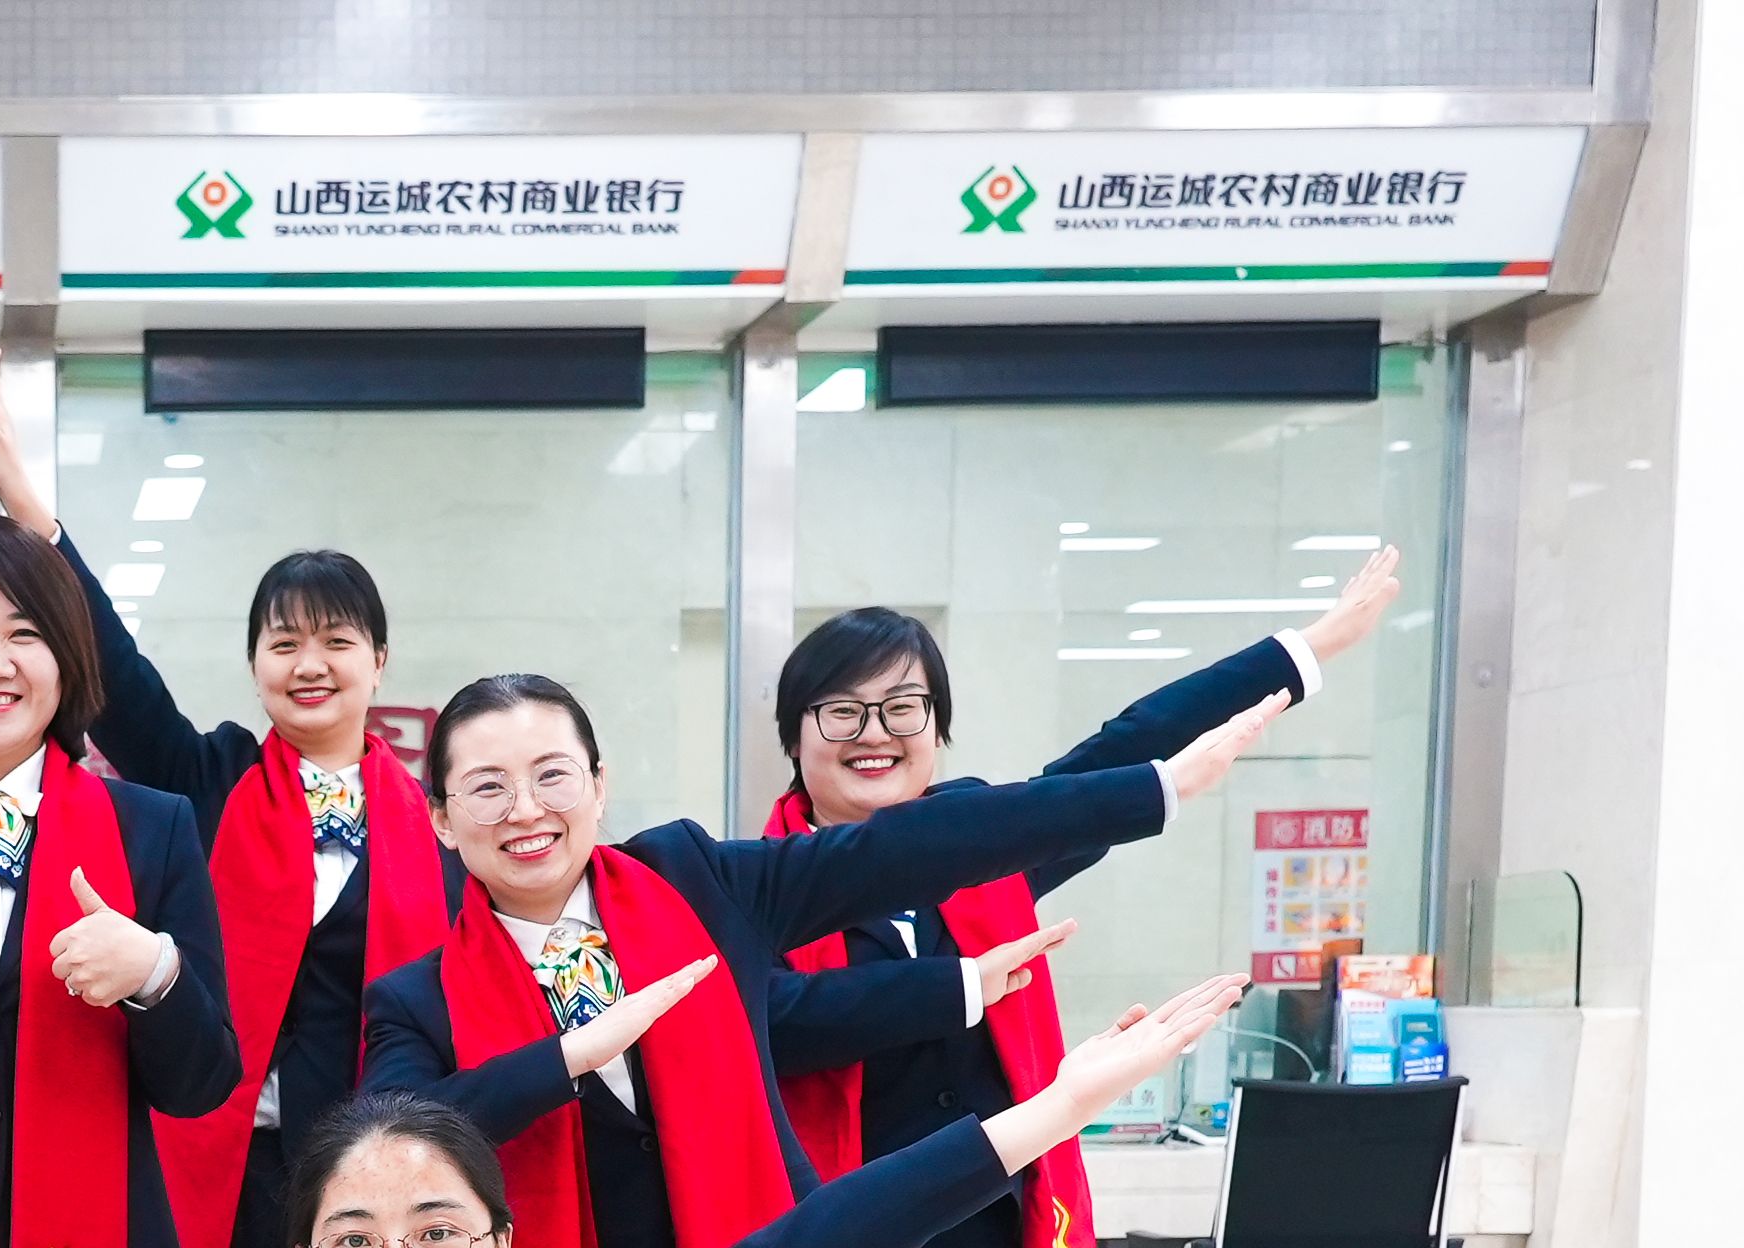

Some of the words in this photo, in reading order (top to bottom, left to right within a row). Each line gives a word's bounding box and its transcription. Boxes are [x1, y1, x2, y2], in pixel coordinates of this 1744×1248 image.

[276, 180, 684, 214] 山西运城农村商业银行
[1058, 171, 1467, 209] 山西运城农村商业银行
[275, 224, 339, 236] SHANXI
[344, 224, 440, 236] YUNCHENG
[446, 224, 505, 236] RURAL
[512, 224, 625, 236] COMMERCIAL
[632, 224, 680, 235] BANK
[1055, 218, 1118, 230] SHANXI
[1125, 217, 1220, 230] YUNCHENG
[1224, 216, 1283, 229] RURAL
[1289, 215, 1401, 228] COMMERCIAL
[1408, 213, 1457, 226] BANK
